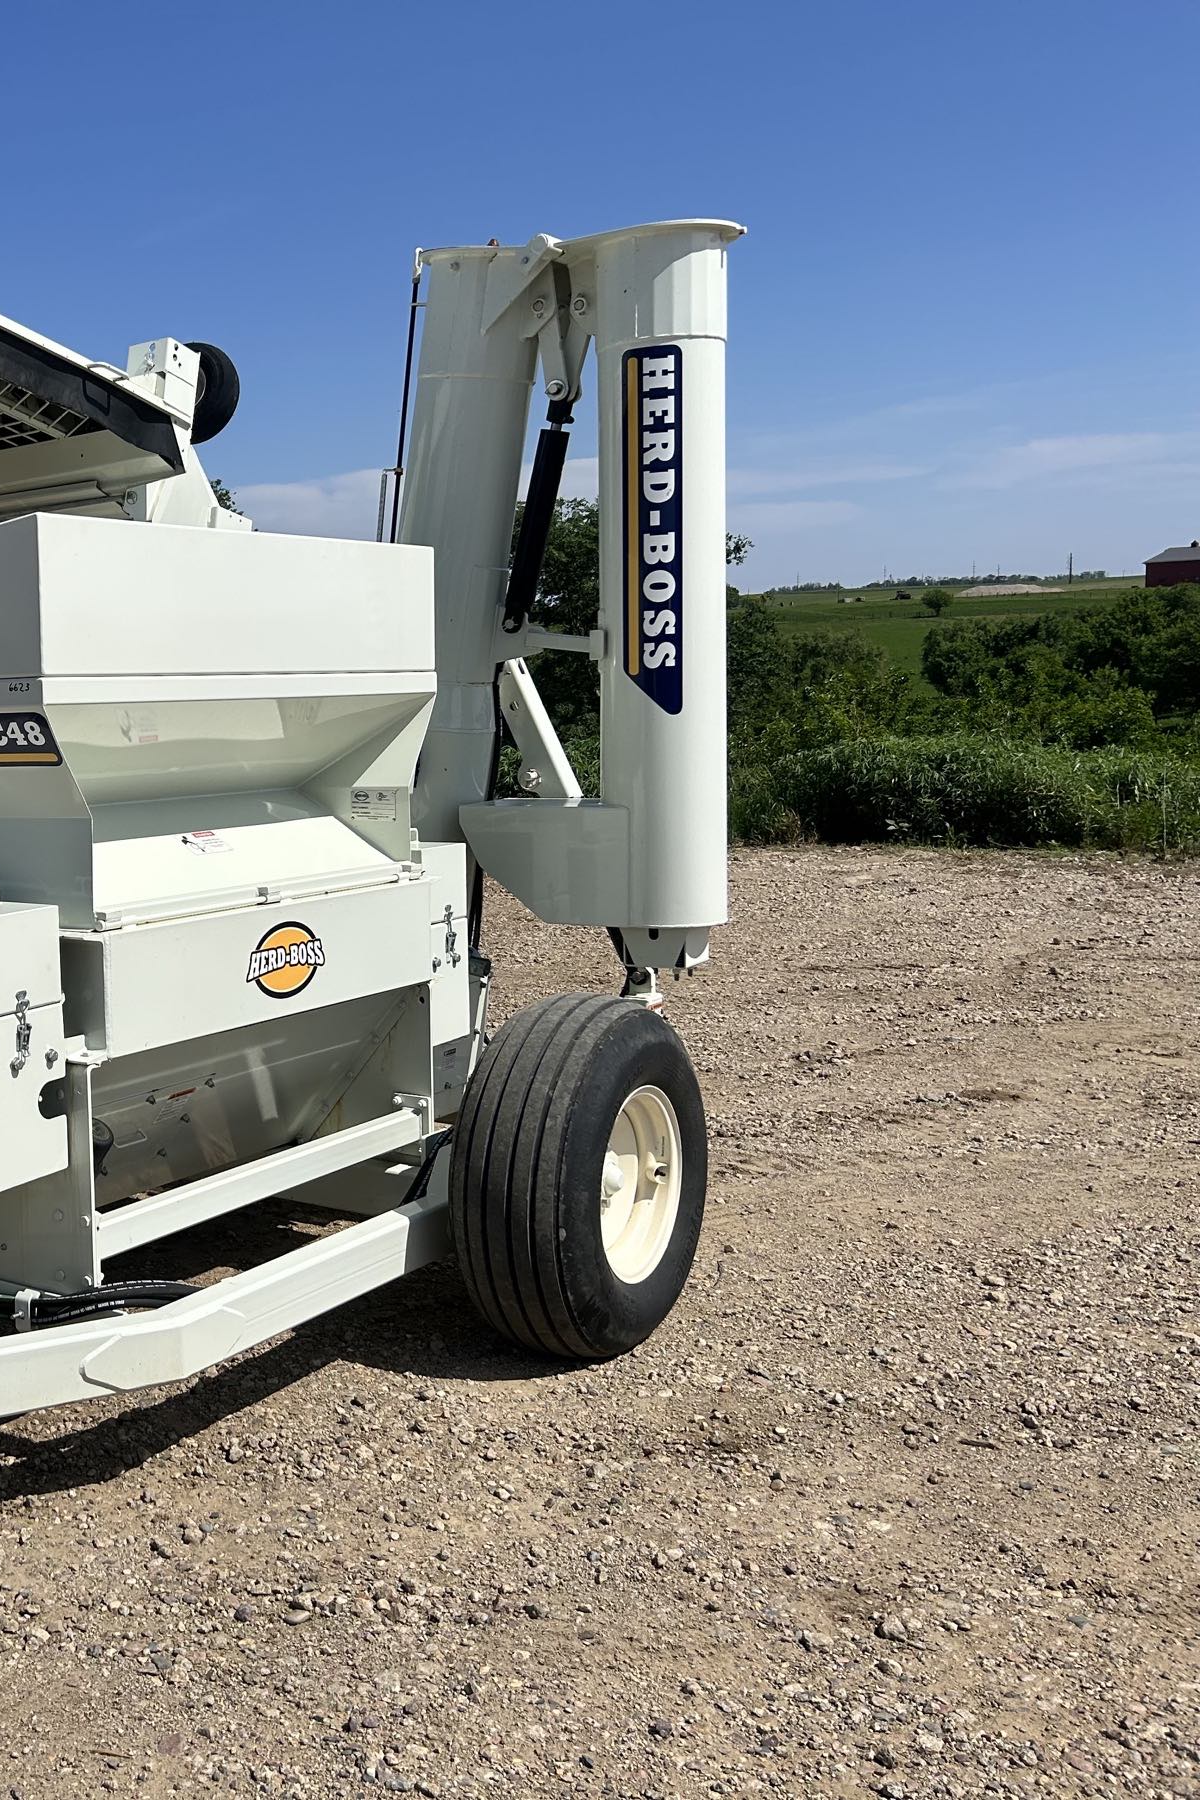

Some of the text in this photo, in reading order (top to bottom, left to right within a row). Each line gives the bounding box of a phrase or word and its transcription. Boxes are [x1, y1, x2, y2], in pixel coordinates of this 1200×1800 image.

[642, 355, 676, 669] HERD-BOSS
[8, 682, 30, 692] 6623
[247, 939, 325, 982] HERD-BOSS
